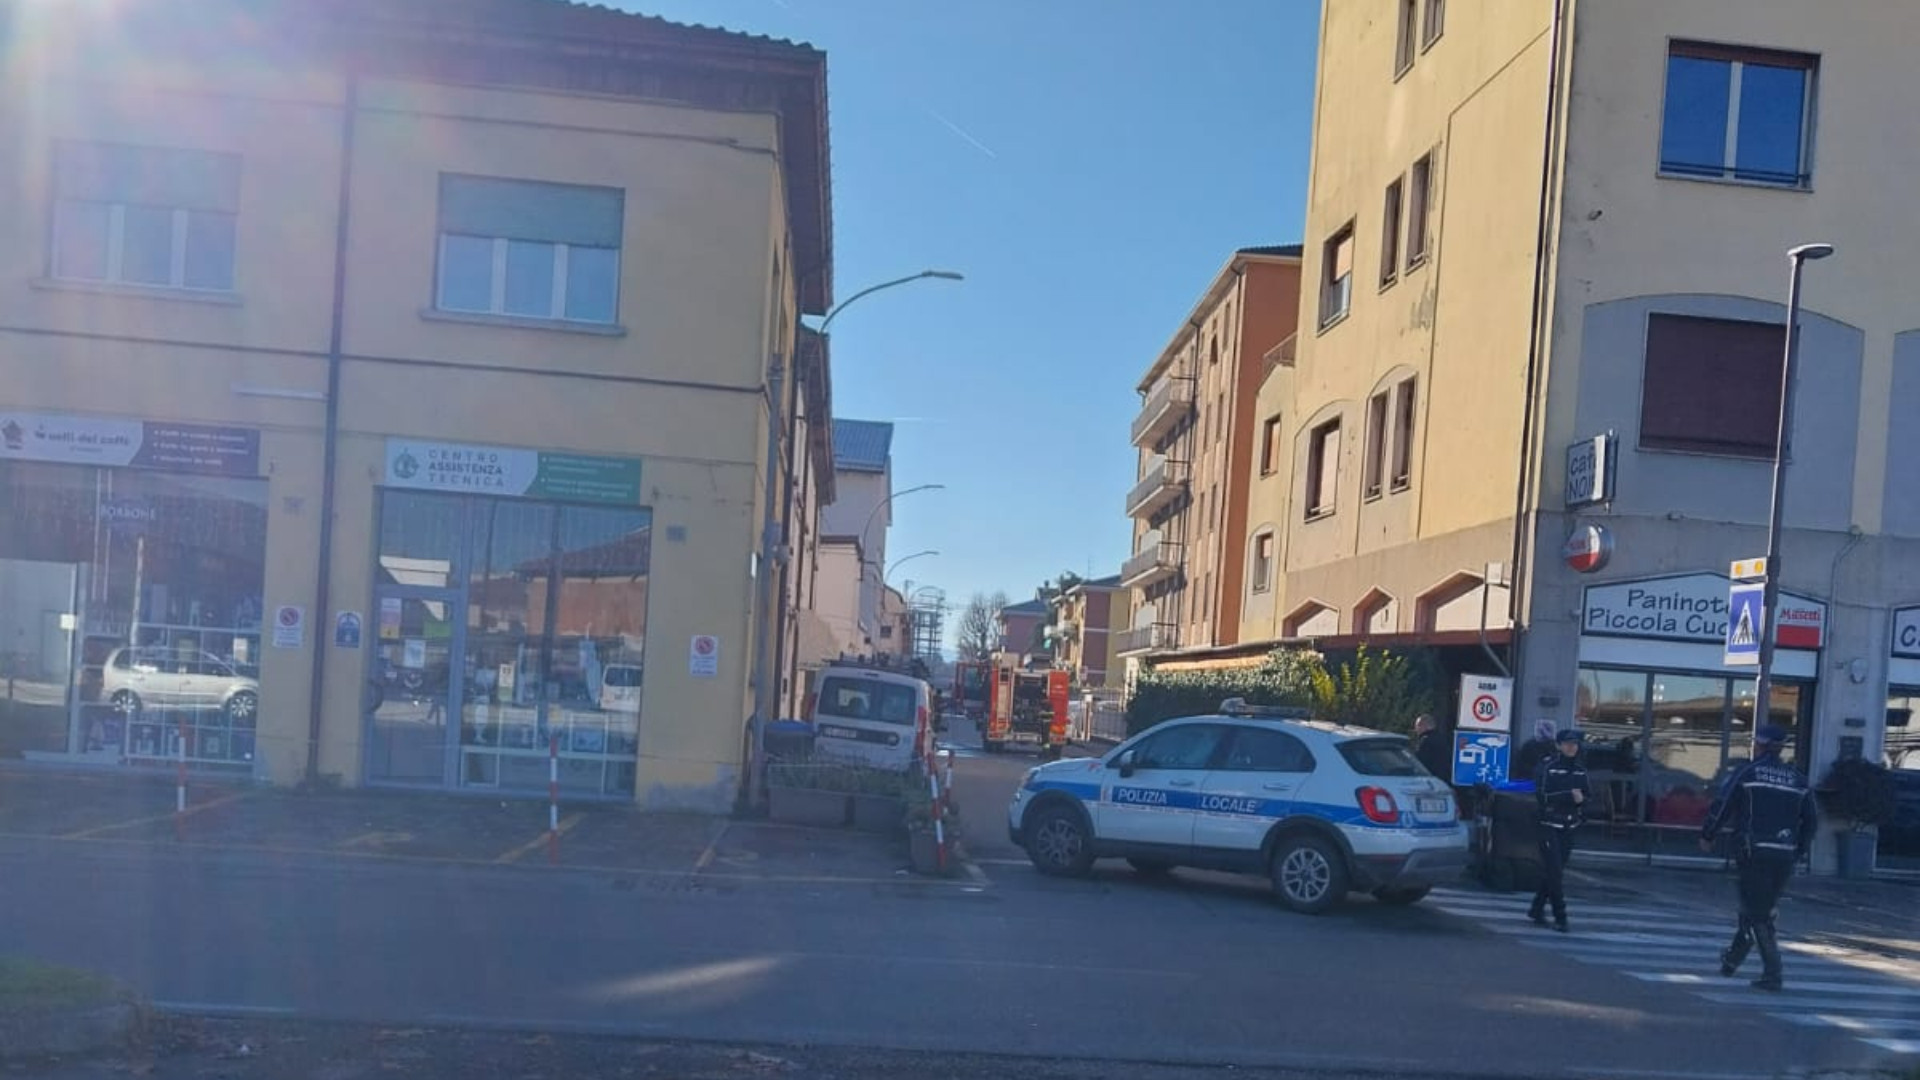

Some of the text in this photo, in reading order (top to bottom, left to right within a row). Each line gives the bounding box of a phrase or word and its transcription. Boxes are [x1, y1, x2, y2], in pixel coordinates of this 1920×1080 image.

[428, 449, 498, 463] CENTRO
[1570, 454, 1596, 475] caf
[428, 462, 503, 475] ASSISTENZA
[428, 473, 504, 487] TECNICA
[1627, 589, 1729, 614] Paninot
[1588, 607, 1677, 631] Piccola
[1479, 702, 1493, 715] 30
[1117, 788, 1258, 813] POLIZIA LOCALE
